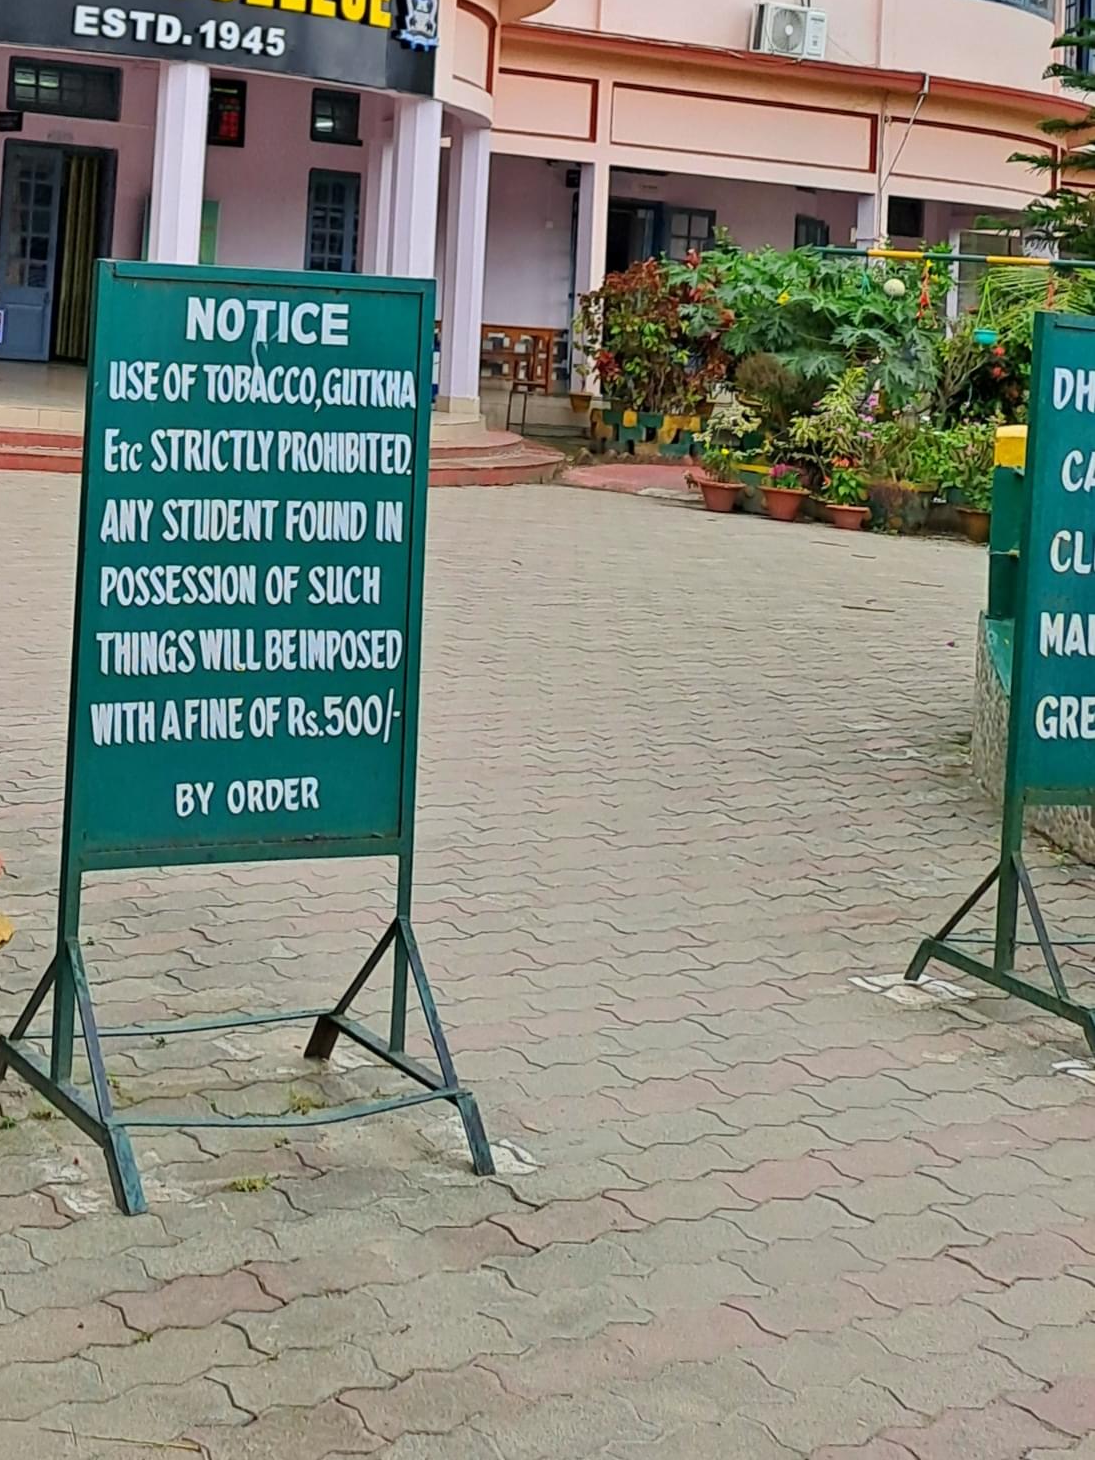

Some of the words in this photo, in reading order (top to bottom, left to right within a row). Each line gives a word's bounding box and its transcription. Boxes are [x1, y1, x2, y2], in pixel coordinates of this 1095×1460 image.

[185, 297, 350, 346] NOTICE
[109, 361, 160, 402] USE
[163, 362, 196, 402] OF
[104, 428, 142, 472] Etc
[150, 428, 275, 473] STRICTLY
[277, 430, 413, 476] PROHIBITED.
[100, 498, 154, 543] ANY
[162, 498, 280, 542] STUDENT
[285, 500, 368, 542] FOUND
[375, 501, 403, 543] IN
[100, 565, 256, 607] POSSESSION
[264, 565, 300, 605] OF
[307, 565, 381, 605] SUCH
[96, 629, 197, 676] THINGS
[199, 628, 262, 671] WILL
[264, 629, 298, 671] BE
[299, 629, 403, 671] IMPOSED
[90, 701, 155, 746] WITH
[161, 700, 183, 741] A
[184, 697, 244, 740] FINE
[248, 696, 282, 738] OF
[175, 781, 215, 818] BY
[226, 776, 320, 815] ORDER
